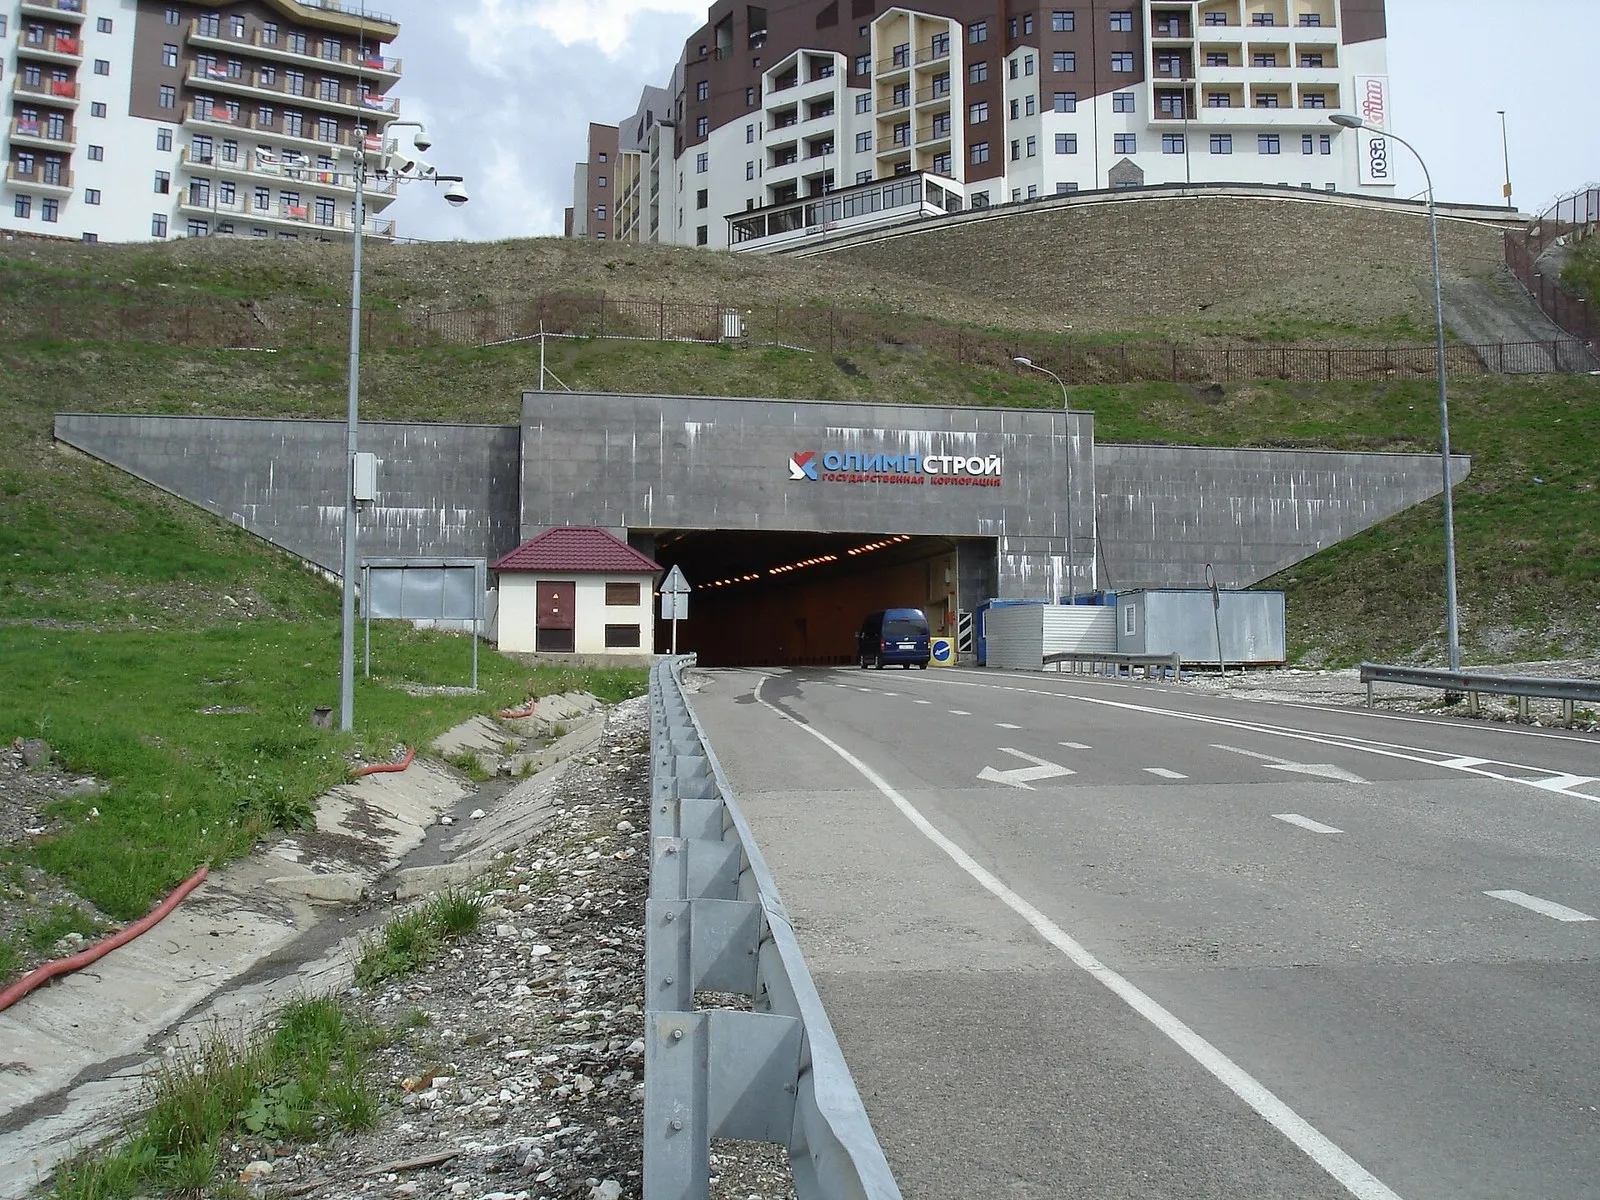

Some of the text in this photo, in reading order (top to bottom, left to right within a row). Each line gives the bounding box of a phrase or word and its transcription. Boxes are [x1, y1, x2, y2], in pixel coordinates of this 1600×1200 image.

[1370, 138, 1387, 178] rosa
[823, 451, 1001, 476] ОЛИМПСТРОЙ
[822, 473, 1001, 487] ГОСУДАРСТВЕННАЯ КОРПОРАЦИЯ
